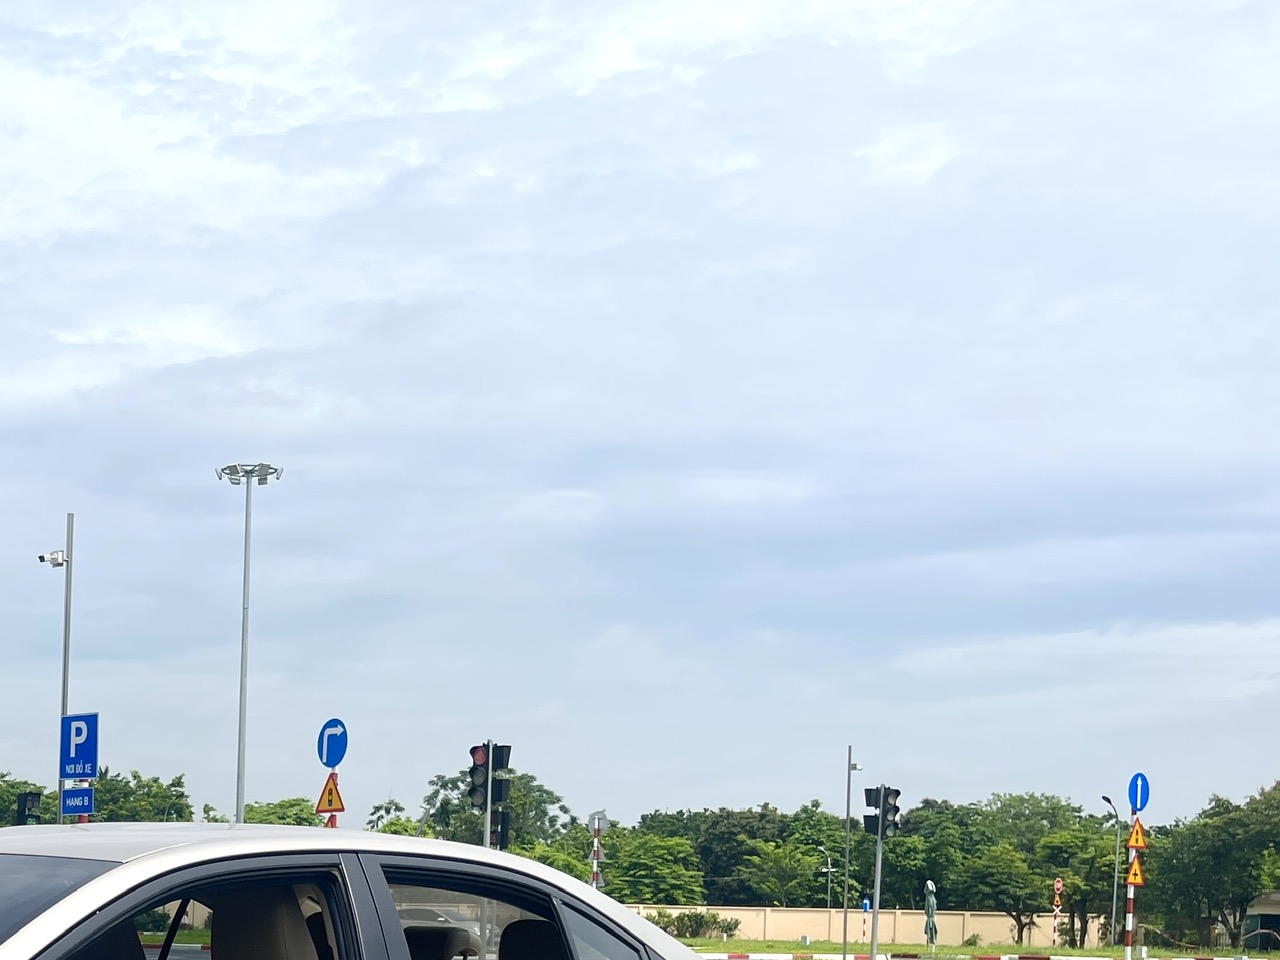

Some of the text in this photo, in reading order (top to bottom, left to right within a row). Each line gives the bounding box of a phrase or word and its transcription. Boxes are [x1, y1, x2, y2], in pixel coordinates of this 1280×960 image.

[70, 721, 87, 758] P
[84, 763, 92, 773] XE
[66, 796, 89, 808] HẠNG B
